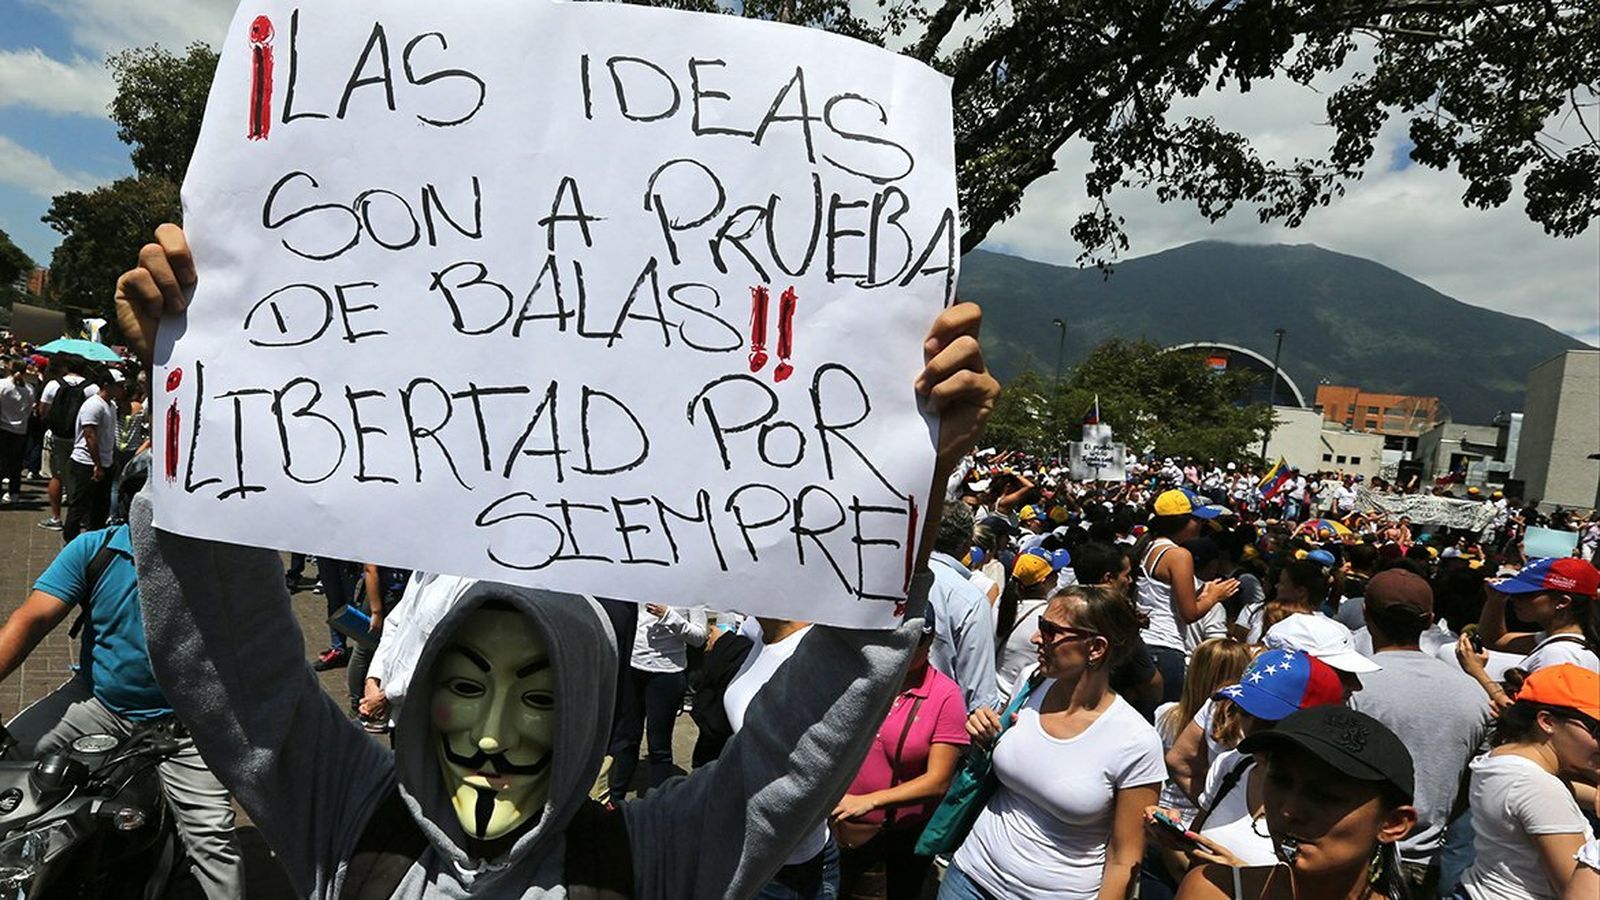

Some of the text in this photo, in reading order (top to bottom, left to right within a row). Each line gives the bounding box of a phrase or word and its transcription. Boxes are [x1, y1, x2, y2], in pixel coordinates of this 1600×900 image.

[247, 9, 915, 186] ¡LAS IDEAS
[262, 158, 956, 309] SON A PRUEBA
[243, 254, 798, 384] DE BALAS!!
[165, 360, 914, 502] ¡LIBERTAD POR
[475, 483, 920, 618] SIEMPRE!
